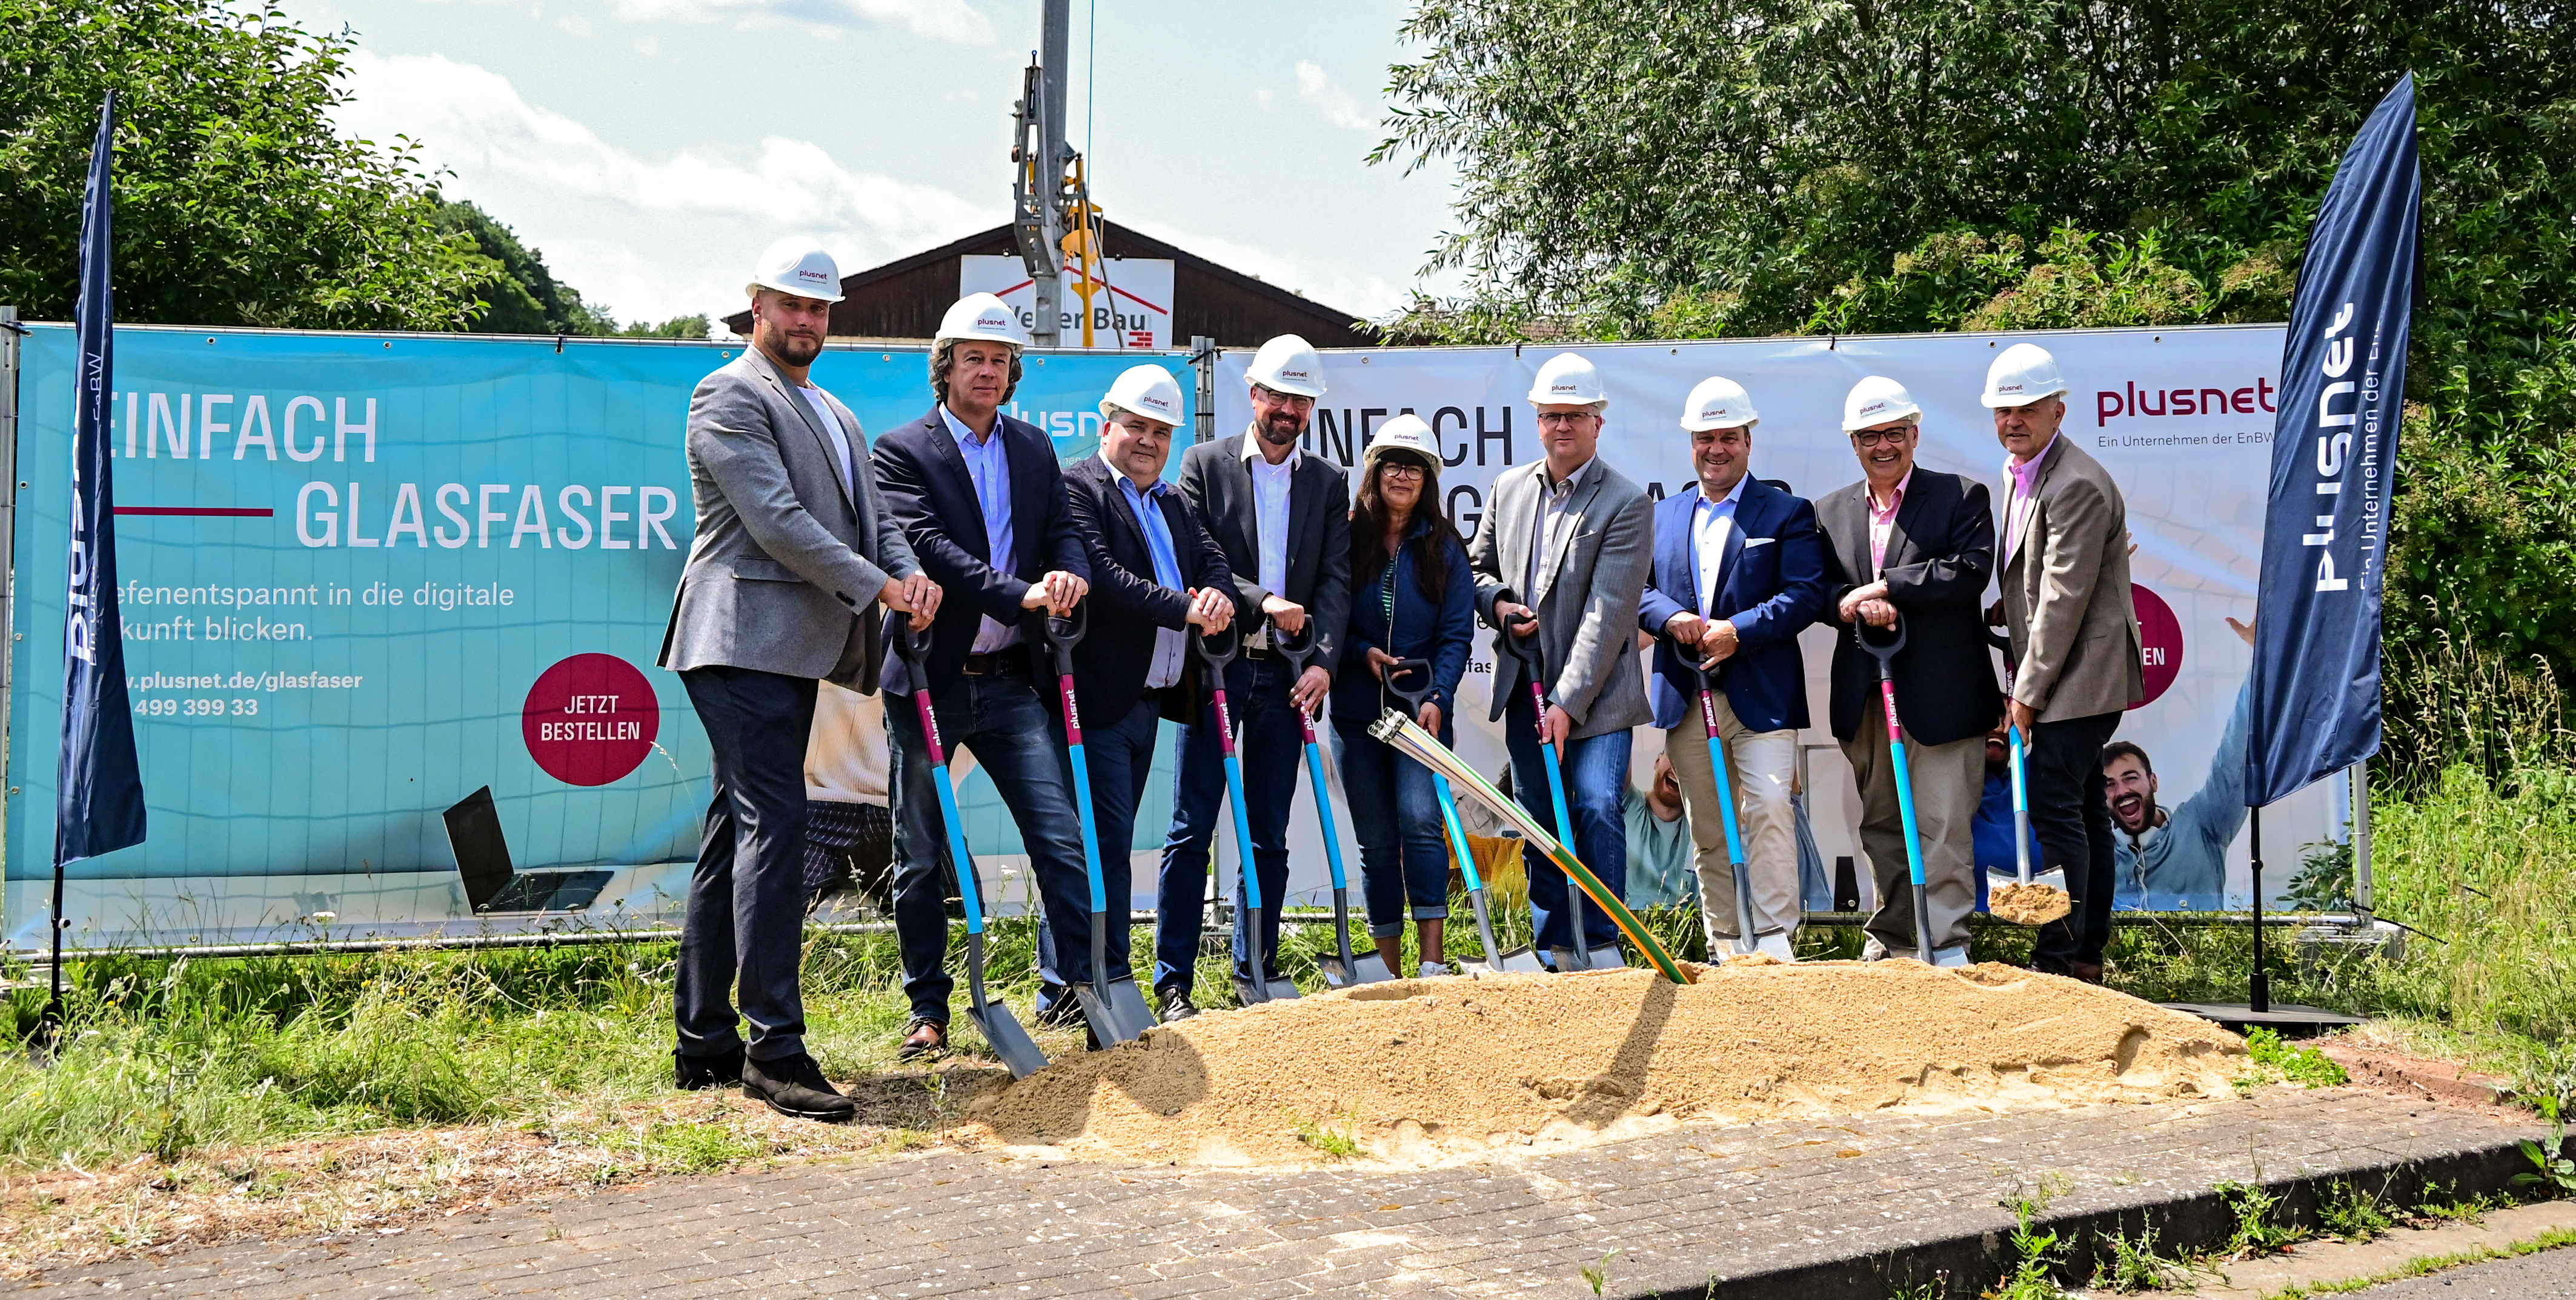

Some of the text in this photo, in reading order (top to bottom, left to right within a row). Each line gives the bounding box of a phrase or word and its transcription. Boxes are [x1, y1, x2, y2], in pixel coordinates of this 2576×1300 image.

[799, 270, 827, 280] plusnet
[1007, 305, 1084, 329] eer
[1094, 308, 1146, 331] Bau
[2361, 369, 2379, 402] der
[1144, 396, 1169, 407] plusnet
[1702, 408, 1727, 418] plusnet
[1860, 402, 1885, 413] plusnet
[2097, 377, 2276, 427] plusnet
[111, 392, 377, 462] INFACH
[2099, 432, 2275, 447] Ein Unternehmen der EnBW
[2360, 409, 2379, 550] Unternehmen
[296, 481, 677, 550] GLASFASER
[329, 582, 351, 605] in
[363, 581, 403, 605] die
[413, 582, 514, 610] digitale
[205, 616, 313, 641] blicken.
[134, 698, 258, 716] 499 399 33
[564, 695, 619, 715] JETZT
[1066, 688, 1080, 729] plusnet
[1702, 695, 1717, 727] plusnet
[1885, 692, 1900, 727] plusnet
[541, 721, 640, 741] BESTELLEN
[1220, 701, 1233, 739] plusnet
